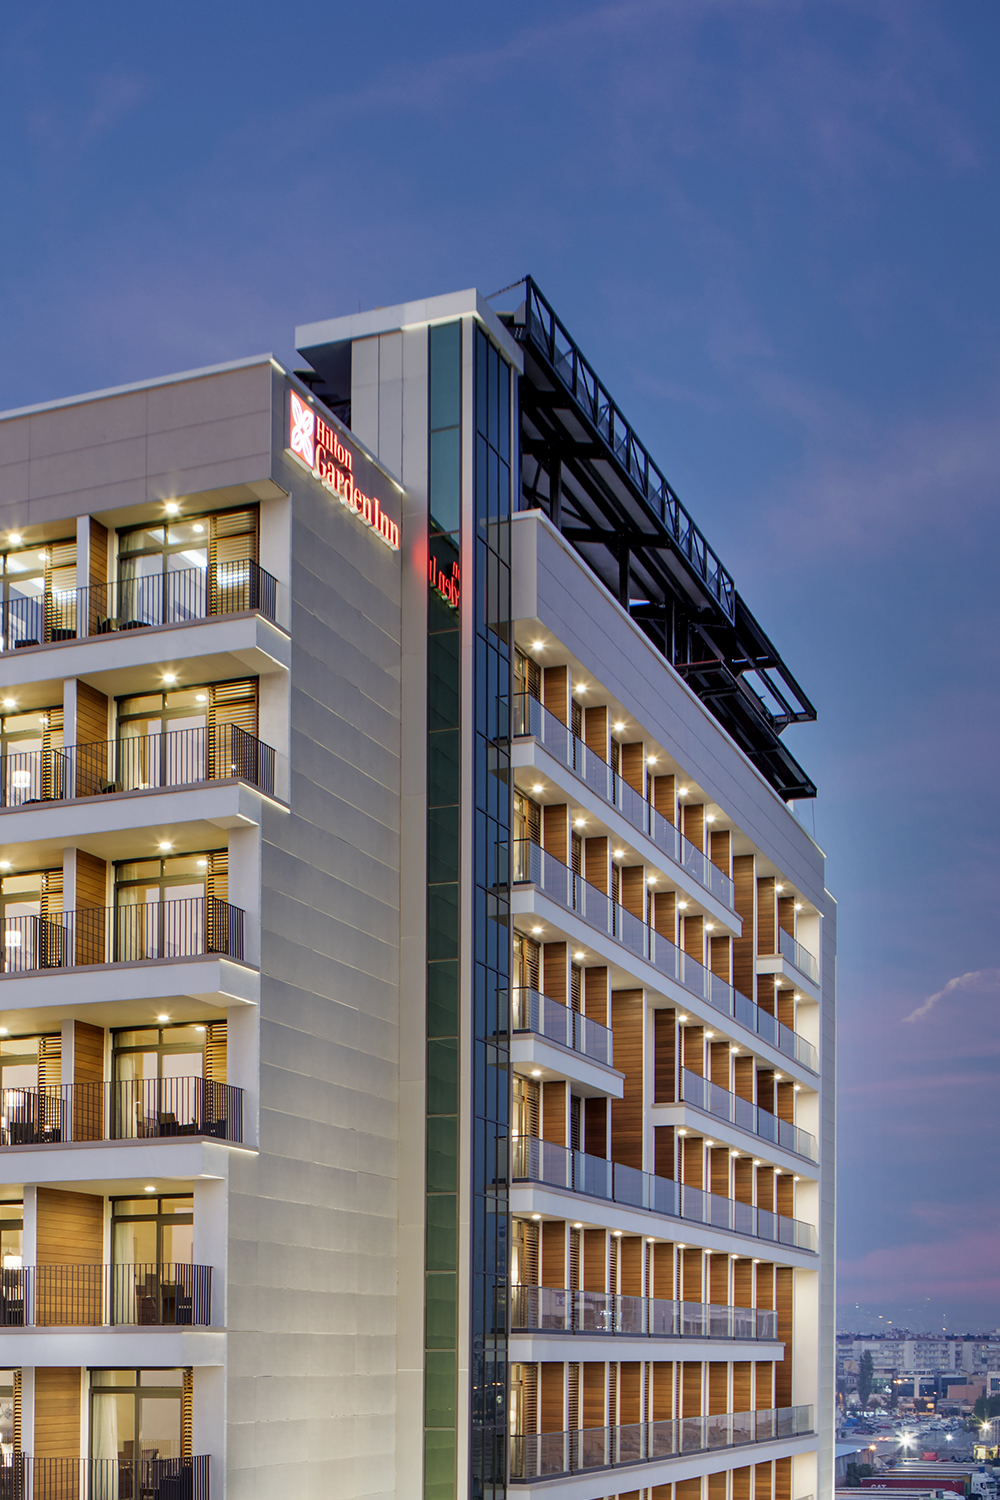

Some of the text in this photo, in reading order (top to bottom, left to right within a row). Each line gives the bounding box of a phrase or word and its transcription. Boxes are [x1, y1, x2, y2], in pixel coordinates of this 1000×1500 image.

[316, 415, 353, 472] Hilton
[315, 443, 400, 550] Garden Inn
